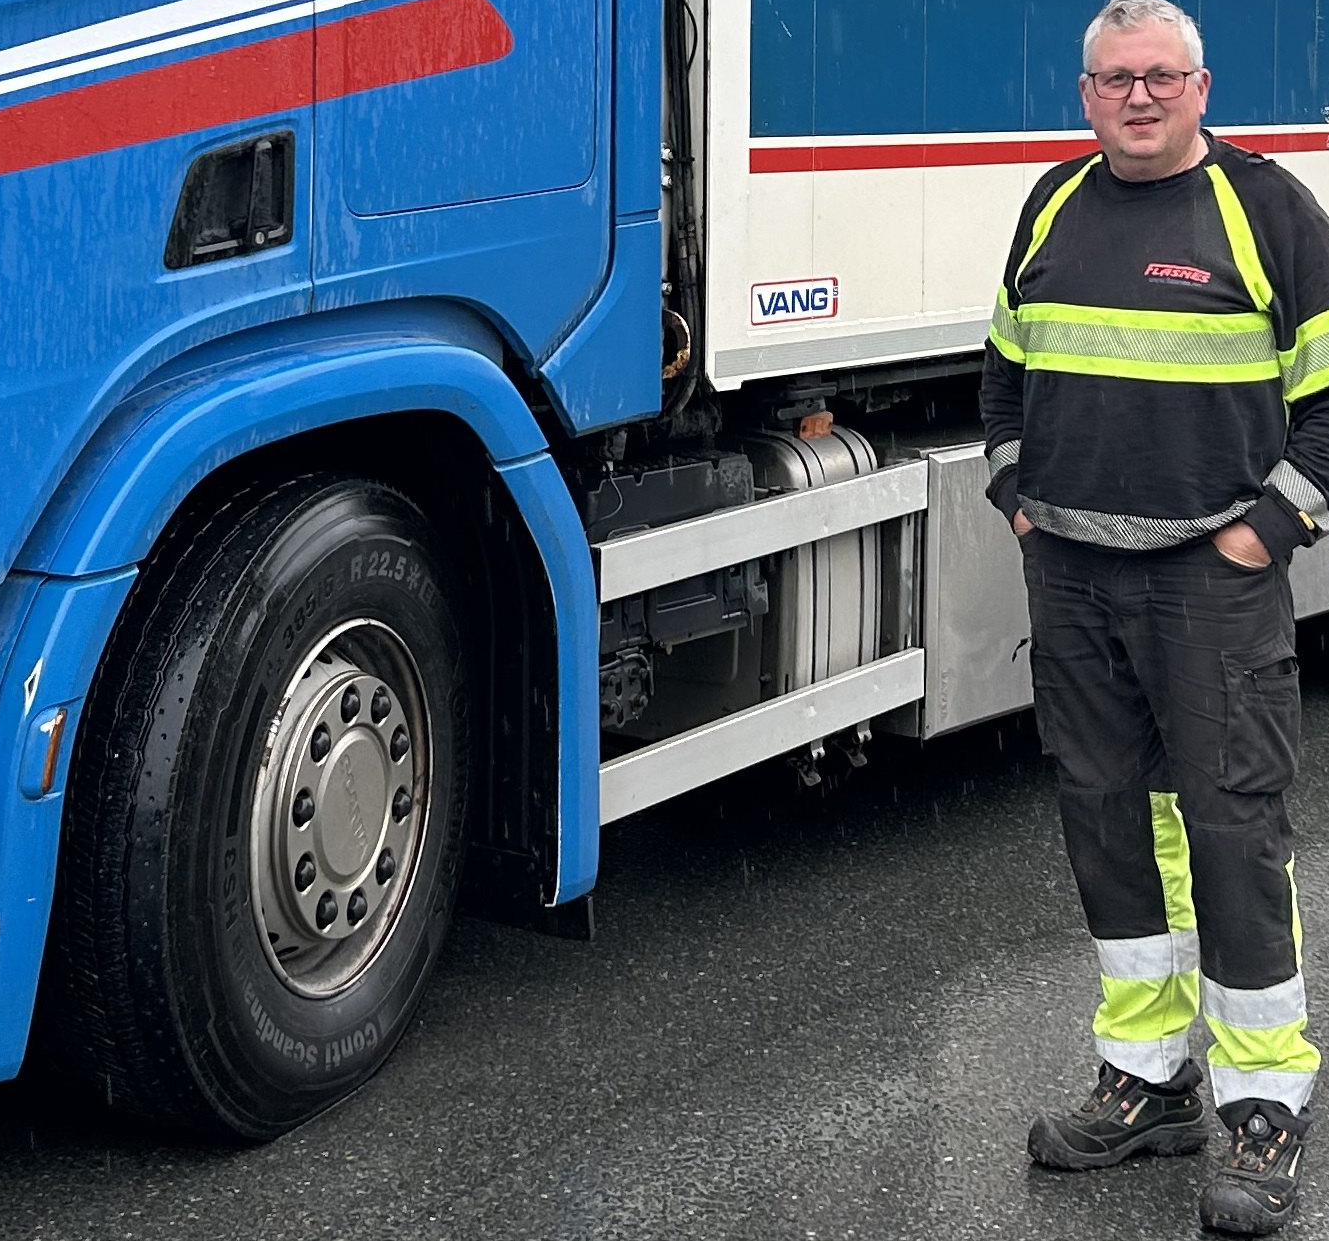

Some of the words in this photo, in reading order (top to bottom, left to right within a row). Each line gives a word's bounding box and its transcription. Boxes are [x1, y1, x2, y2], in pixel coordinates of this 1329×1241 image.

[1144, 263, 1212, 284] FLASNES
[756, 286, 828, 316] VANG
[366, 551, 408, 581] 22.5
[324, 1021, 379, 1071] Conti
